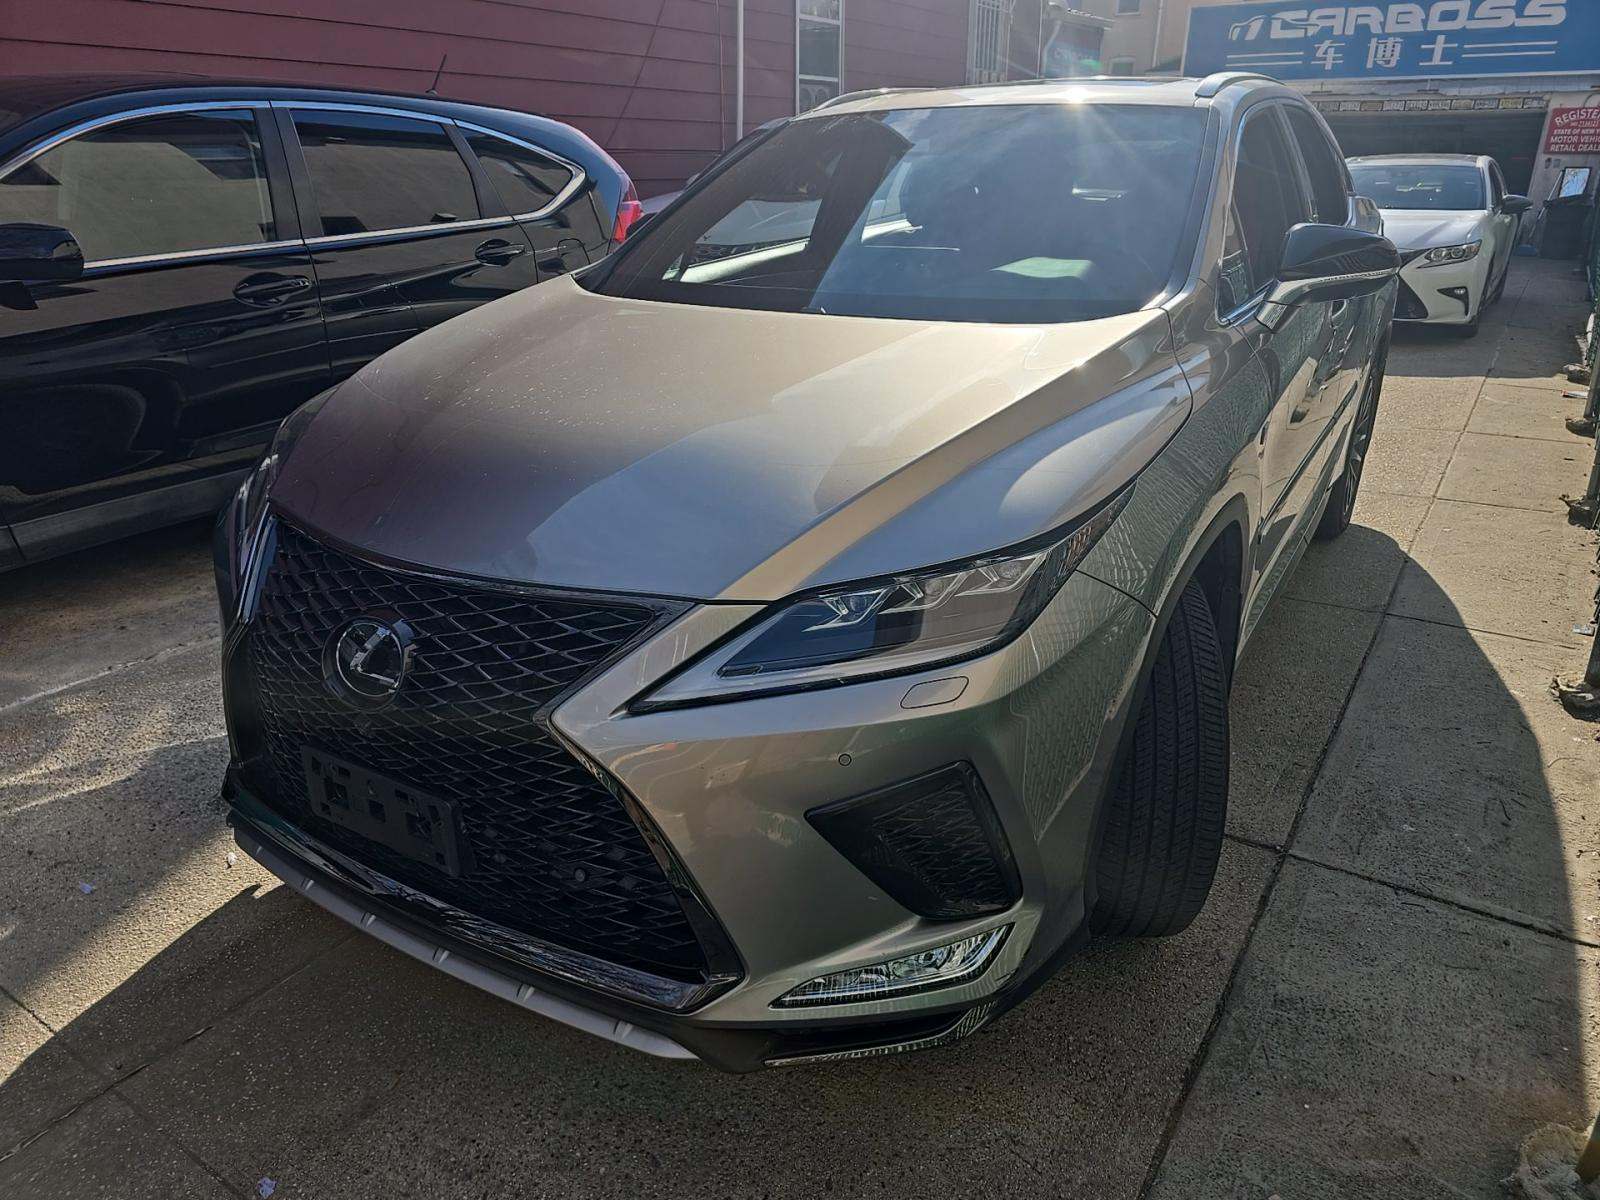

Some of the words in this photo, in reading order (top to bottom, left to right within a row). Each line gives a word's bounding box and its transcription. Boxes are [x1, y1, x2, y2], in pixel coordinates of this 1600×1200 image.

[1269, 0, 1567, 39] CARBOSS
[1310, 34, 1459, 70] 车博士
[1550, 135, 1579, 143] MOTOR
[1550, 143, 1576, 152] RETAIL
